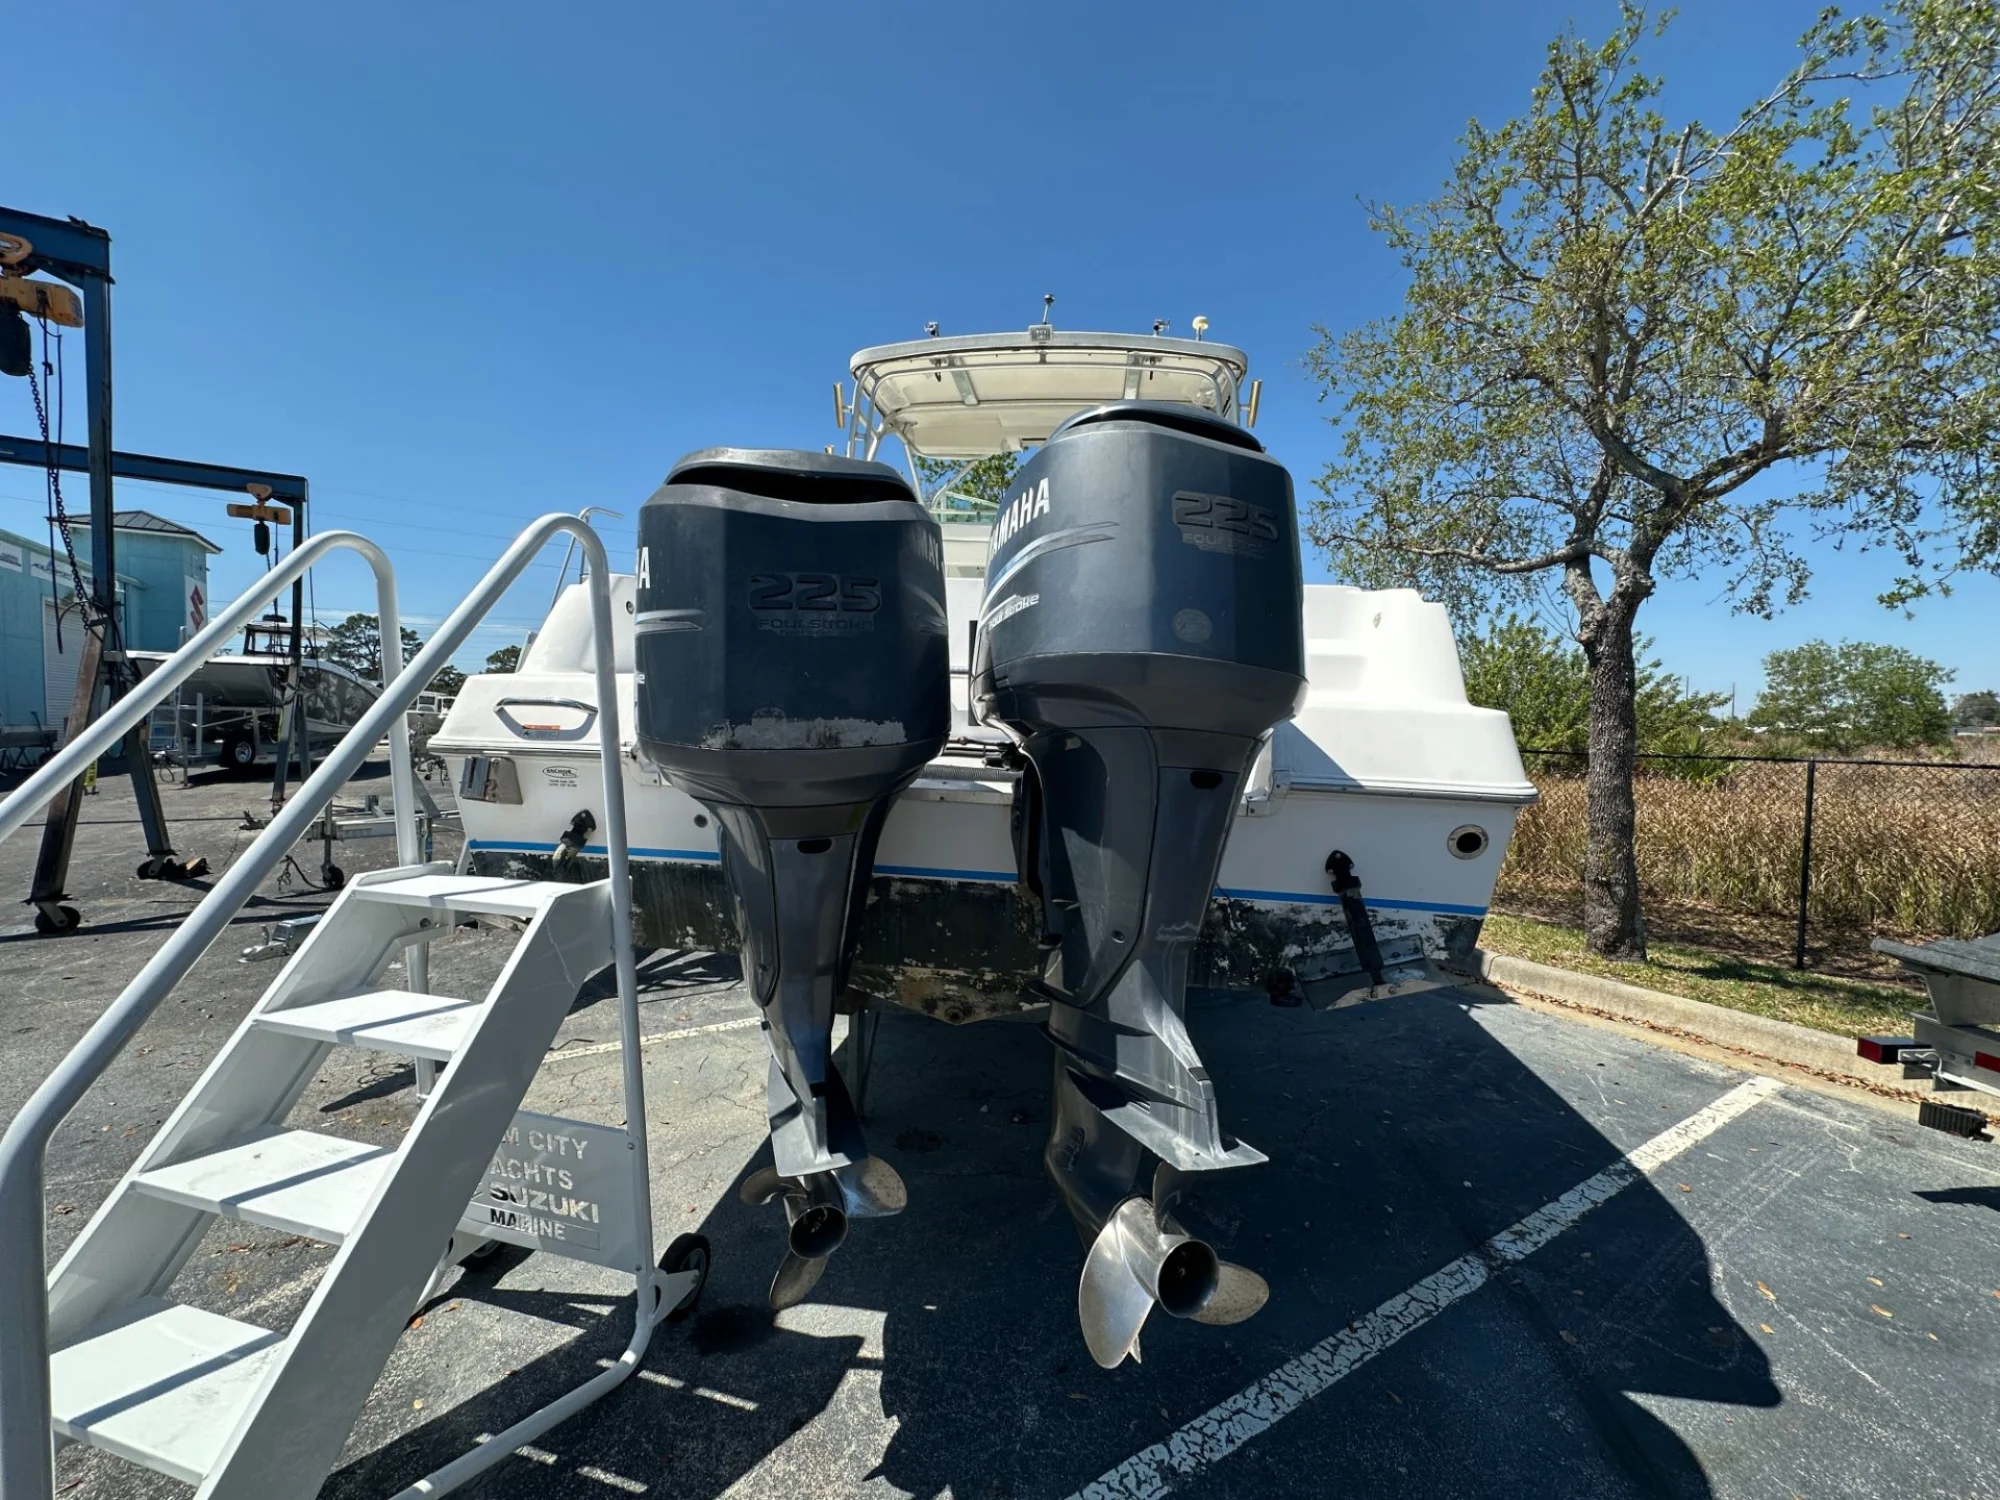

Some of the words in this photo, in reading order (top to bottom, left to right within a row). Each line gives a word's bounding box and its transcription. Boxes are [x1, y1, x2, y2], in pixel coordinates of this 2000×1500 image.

[1174, 491, 1280, 543] 225
[749, 573, 882, 613] 225
[528, 1130, 588, 1159] CITY
[489, 1155, 574, 1190] ACHTS
[489, 1181, 600, 1224] SUZUKI
[490, 1208, 566, 1240] MARINE
